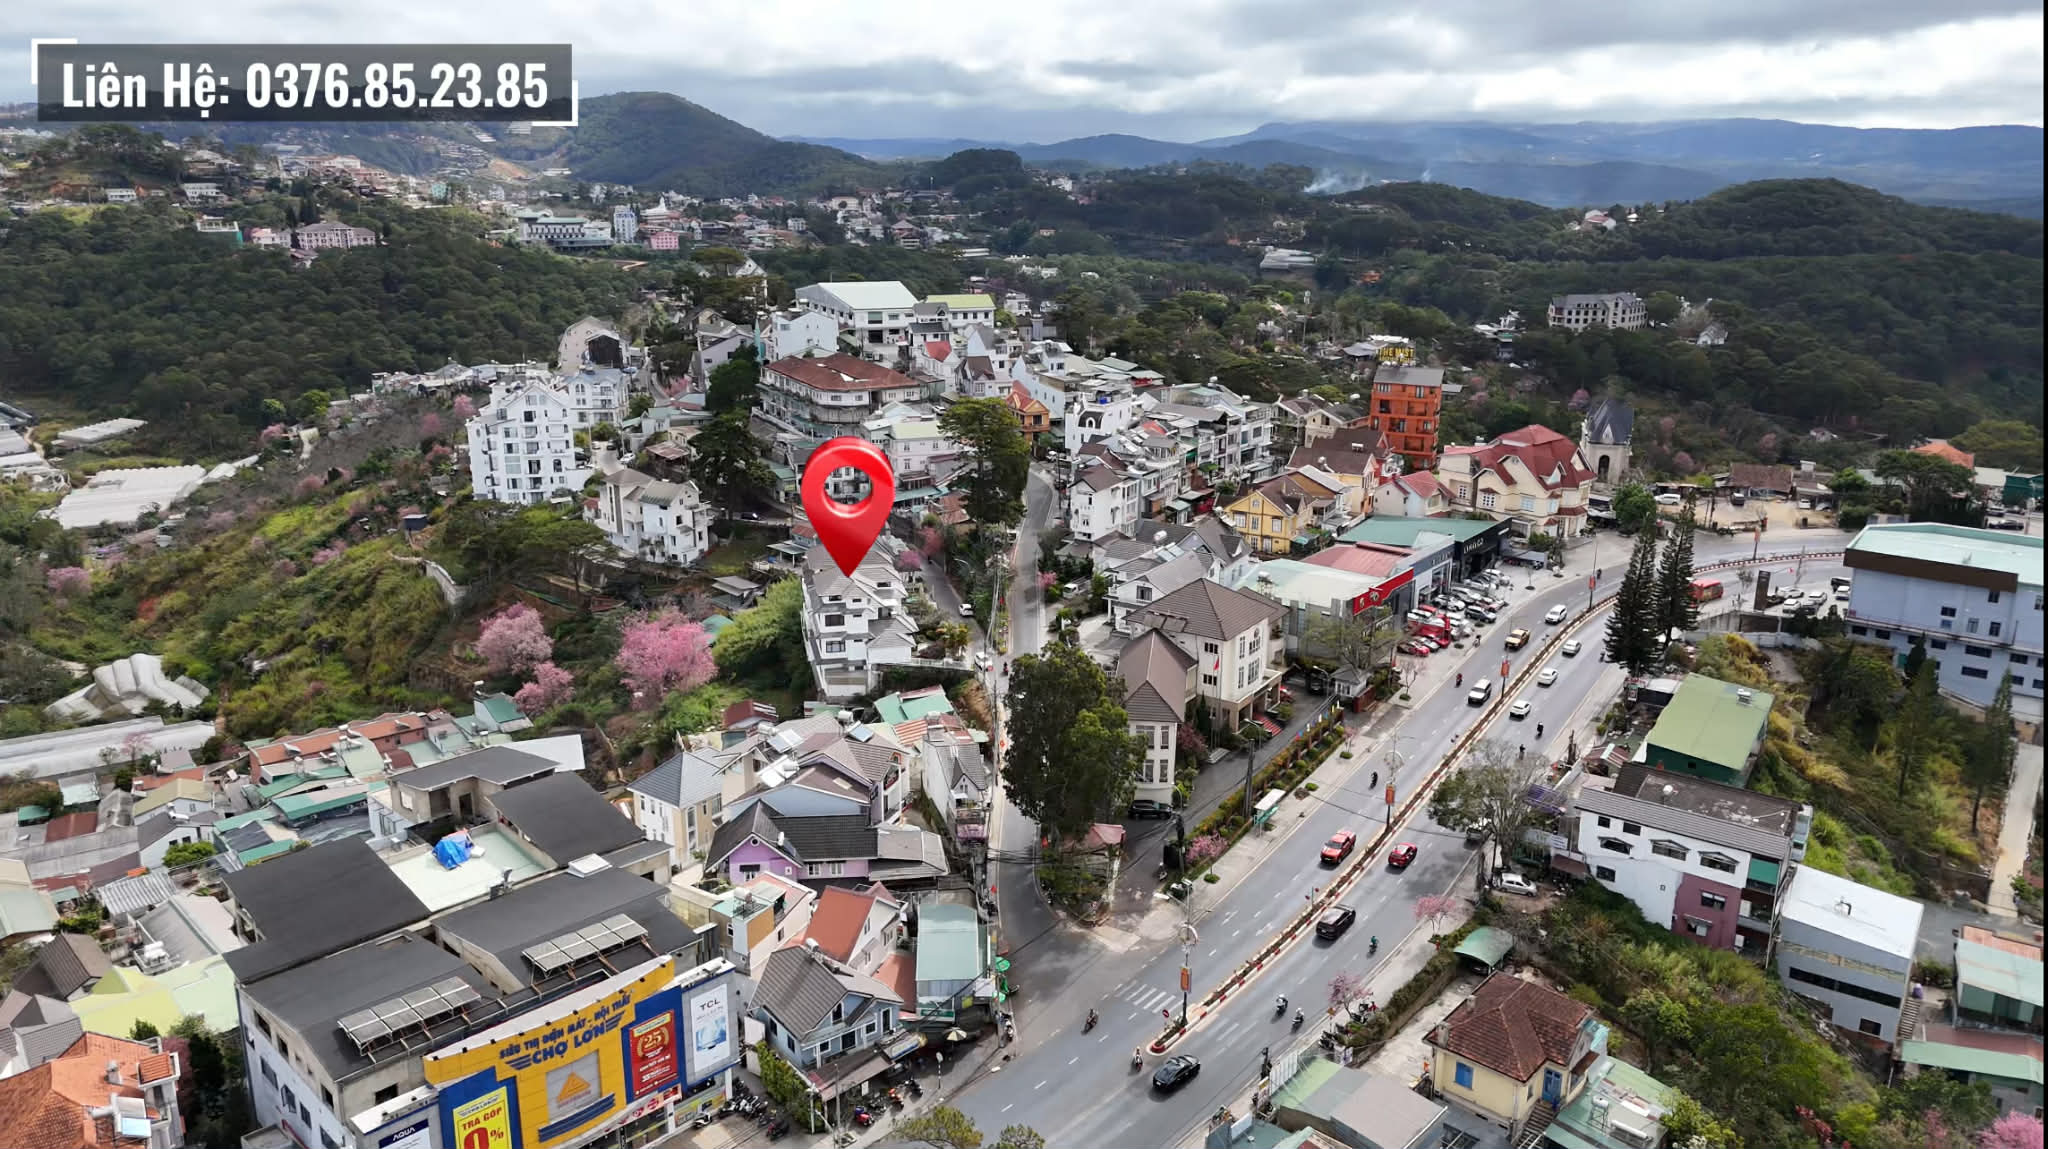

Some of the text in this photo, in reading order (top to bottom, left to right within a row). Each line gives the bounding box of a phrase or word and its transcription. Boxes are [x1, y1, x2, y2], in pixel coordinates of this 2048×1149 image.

[700, 999, 721, 1011] TCL
[532, 1040, 569, 1064] CHỢ
[573, 1022, 606, 1049] LỚN
[392, 1126, 416, 1142] AQUA
